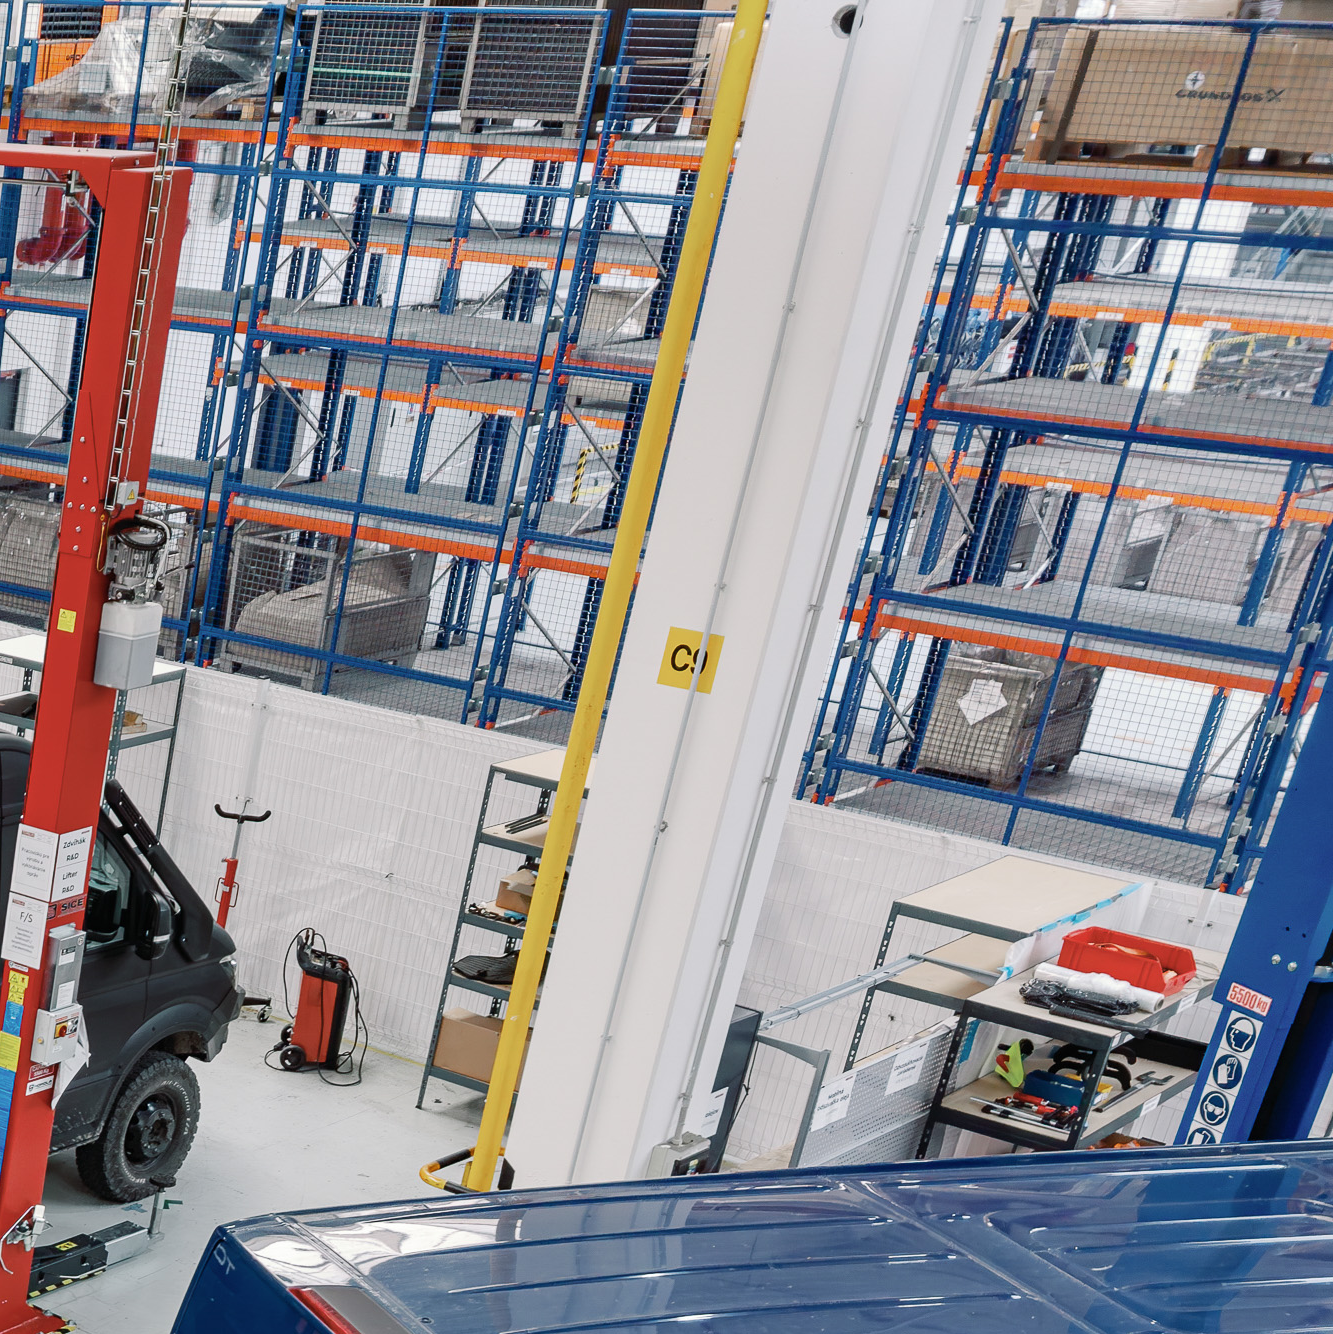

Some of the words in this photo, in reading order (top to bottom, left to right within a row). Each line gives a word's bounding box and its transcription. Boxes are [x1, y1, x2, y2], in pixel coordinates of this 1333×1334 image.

[670, 644, 708, 675] C9
[66, 852, 80, 862] R&D
[62, 870, 78, 880] Lifter
[61, 885, 75, 894] R&D
[61, 899, 84, 912] SICE
[19, 911, 33, 923] F/S
